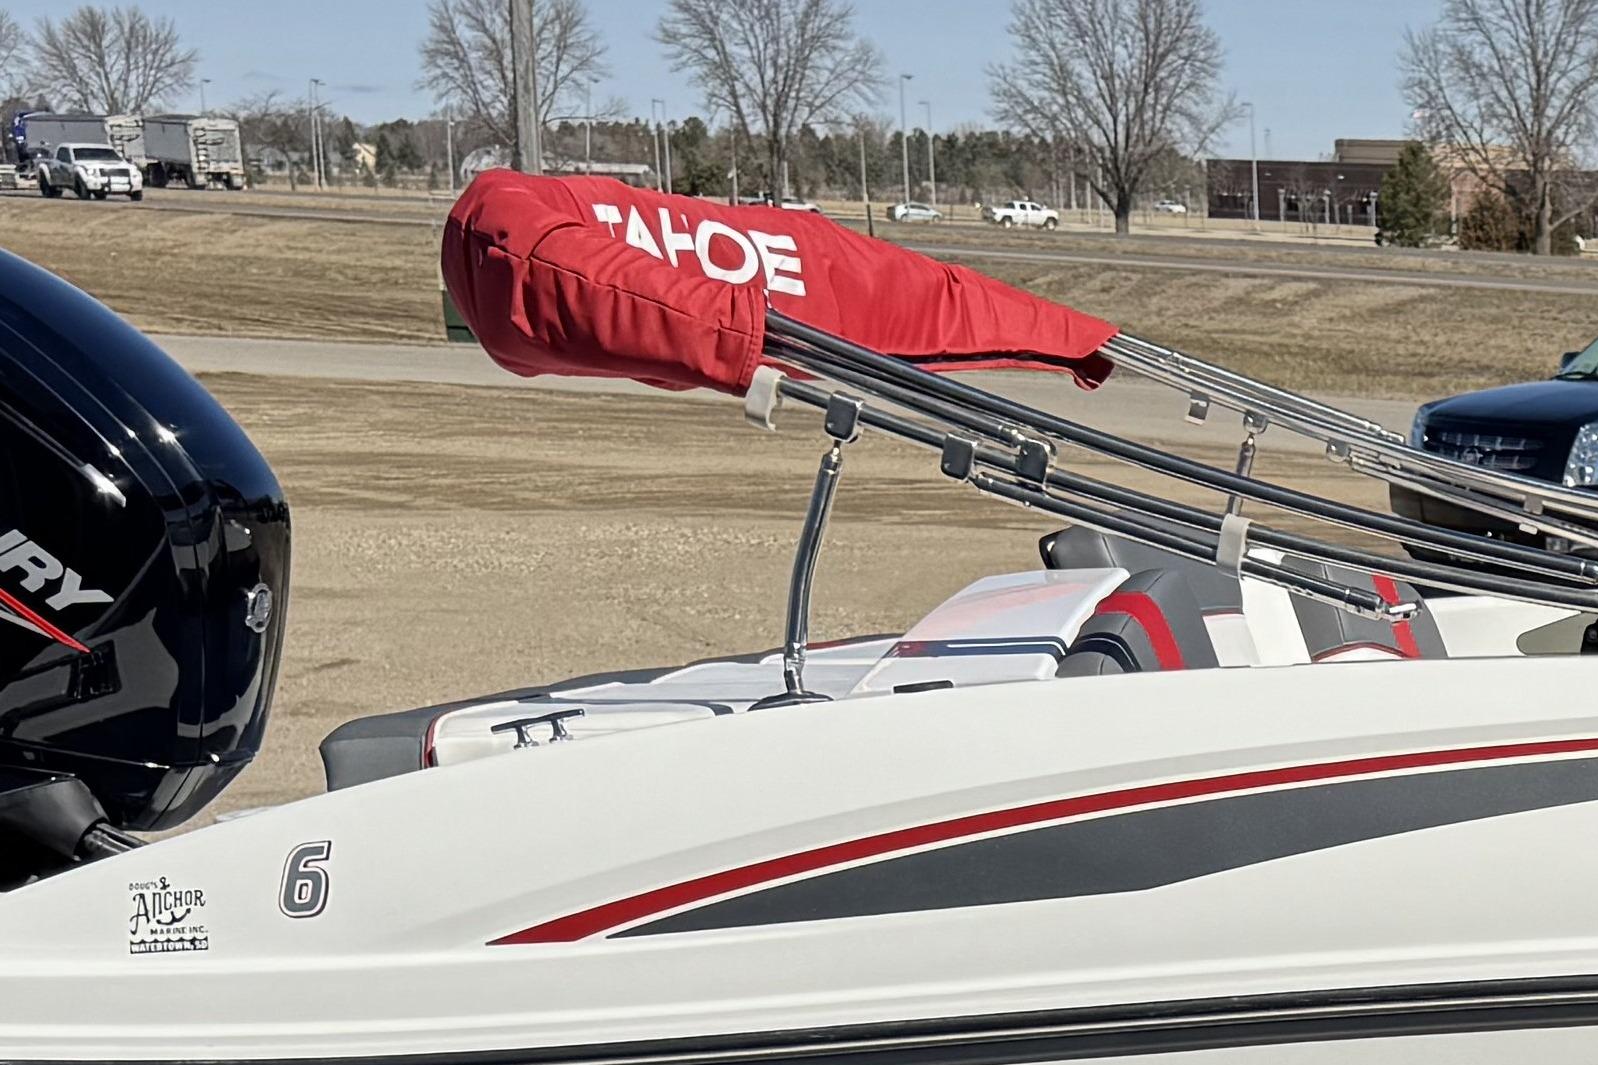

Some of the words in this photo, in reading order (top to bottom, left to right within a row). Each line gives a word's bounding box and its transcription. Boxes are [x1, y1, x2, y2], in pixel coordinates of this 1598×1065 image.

[592, 203, 806, 298] TAHOE
[278, 840, 332, 919] 6
[129, 889, 206, 936] ANCHOR
[150, 926, 187, 936] MARINE
[188, 924, 209, 934] INC.
